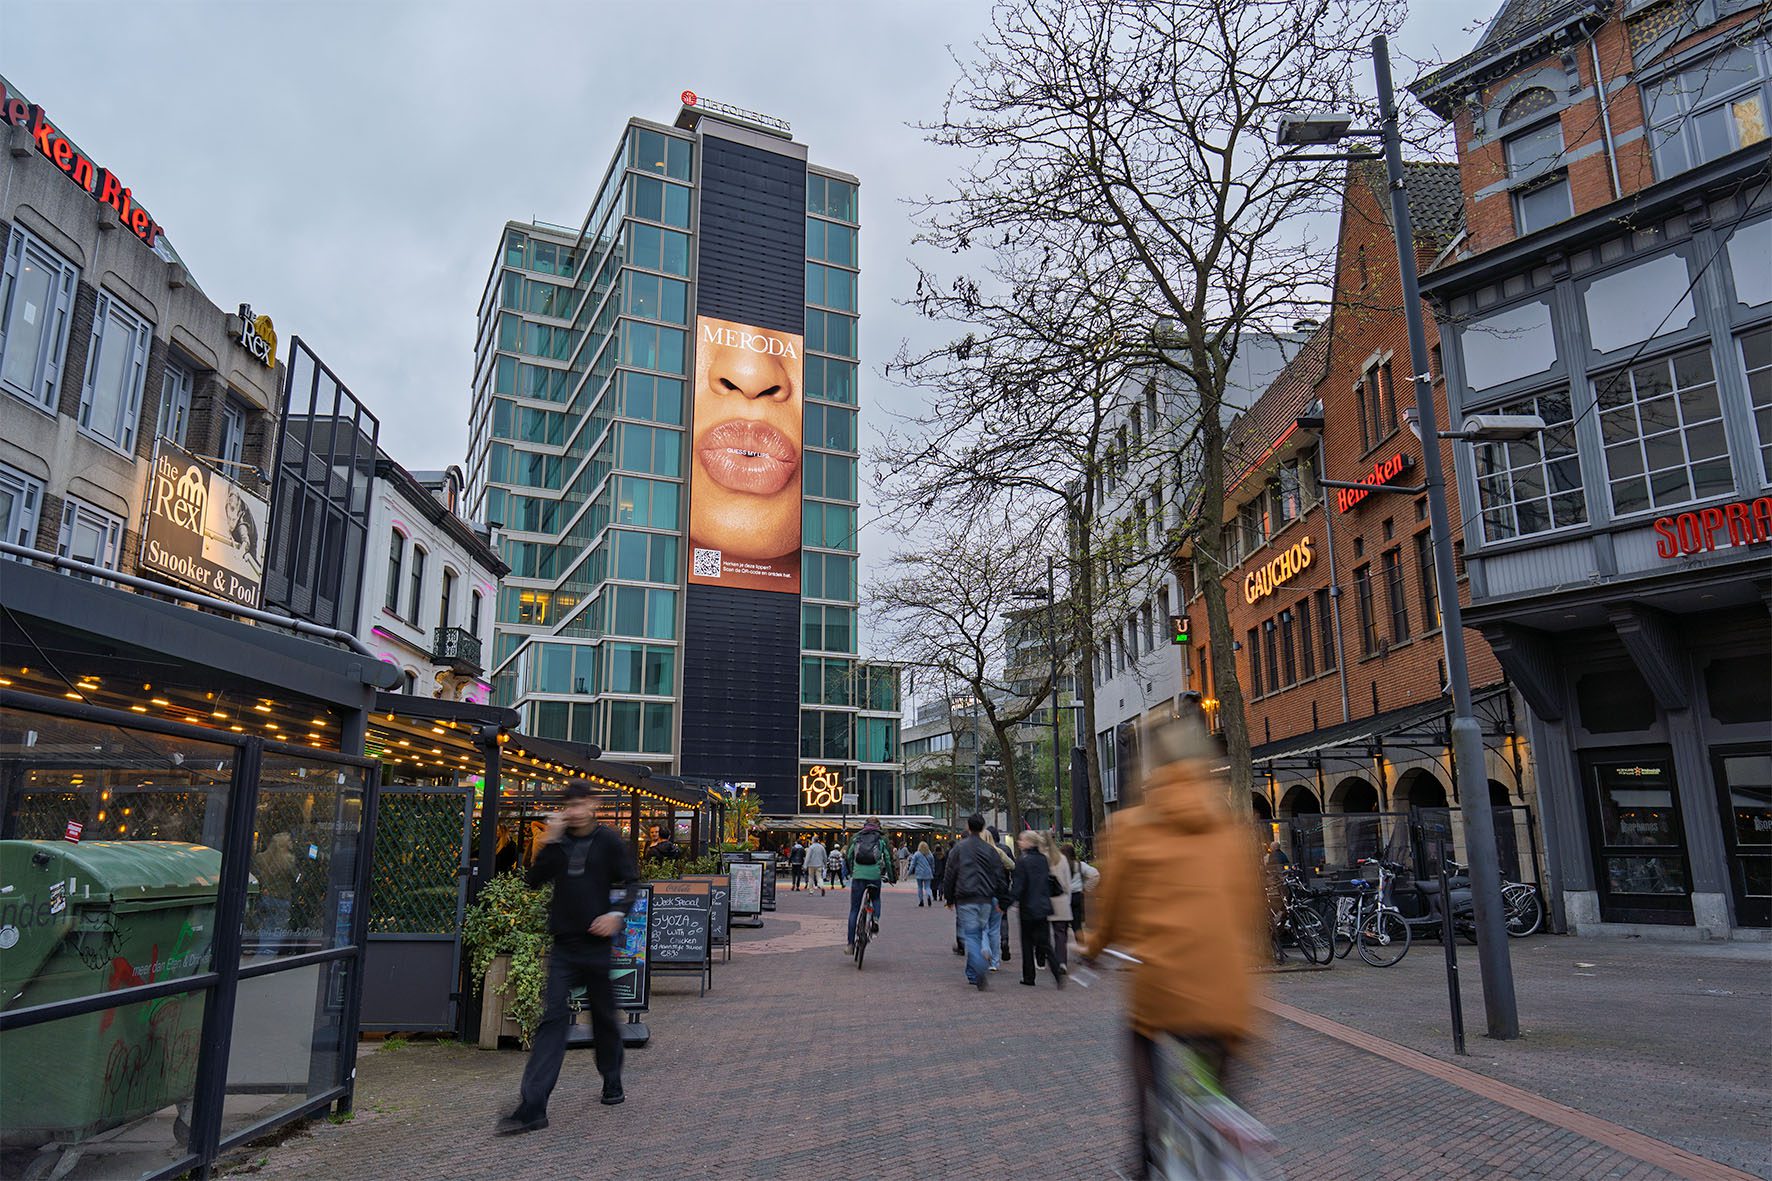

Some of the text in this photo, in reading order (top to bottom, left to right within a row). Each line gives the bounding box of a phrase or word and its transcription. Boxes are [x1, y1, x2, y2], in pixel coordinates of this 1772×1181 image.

[100, 168, 164, 248] Bier
[241, 316, 272, 366] Rex
[704, 325, 798, 359] MERODA
[158, 455, 179, 481] the
[152, 475, 201, 534] Rex
[1654, 497, 1772, 559] SOPRA
[148, 539, 256, 605] Snooker & Pool
[1245, 536, 1311, 604] GAUCHOS
[802, 772, 839, 793] LOU
[806, 786, 843, 807] LOU
